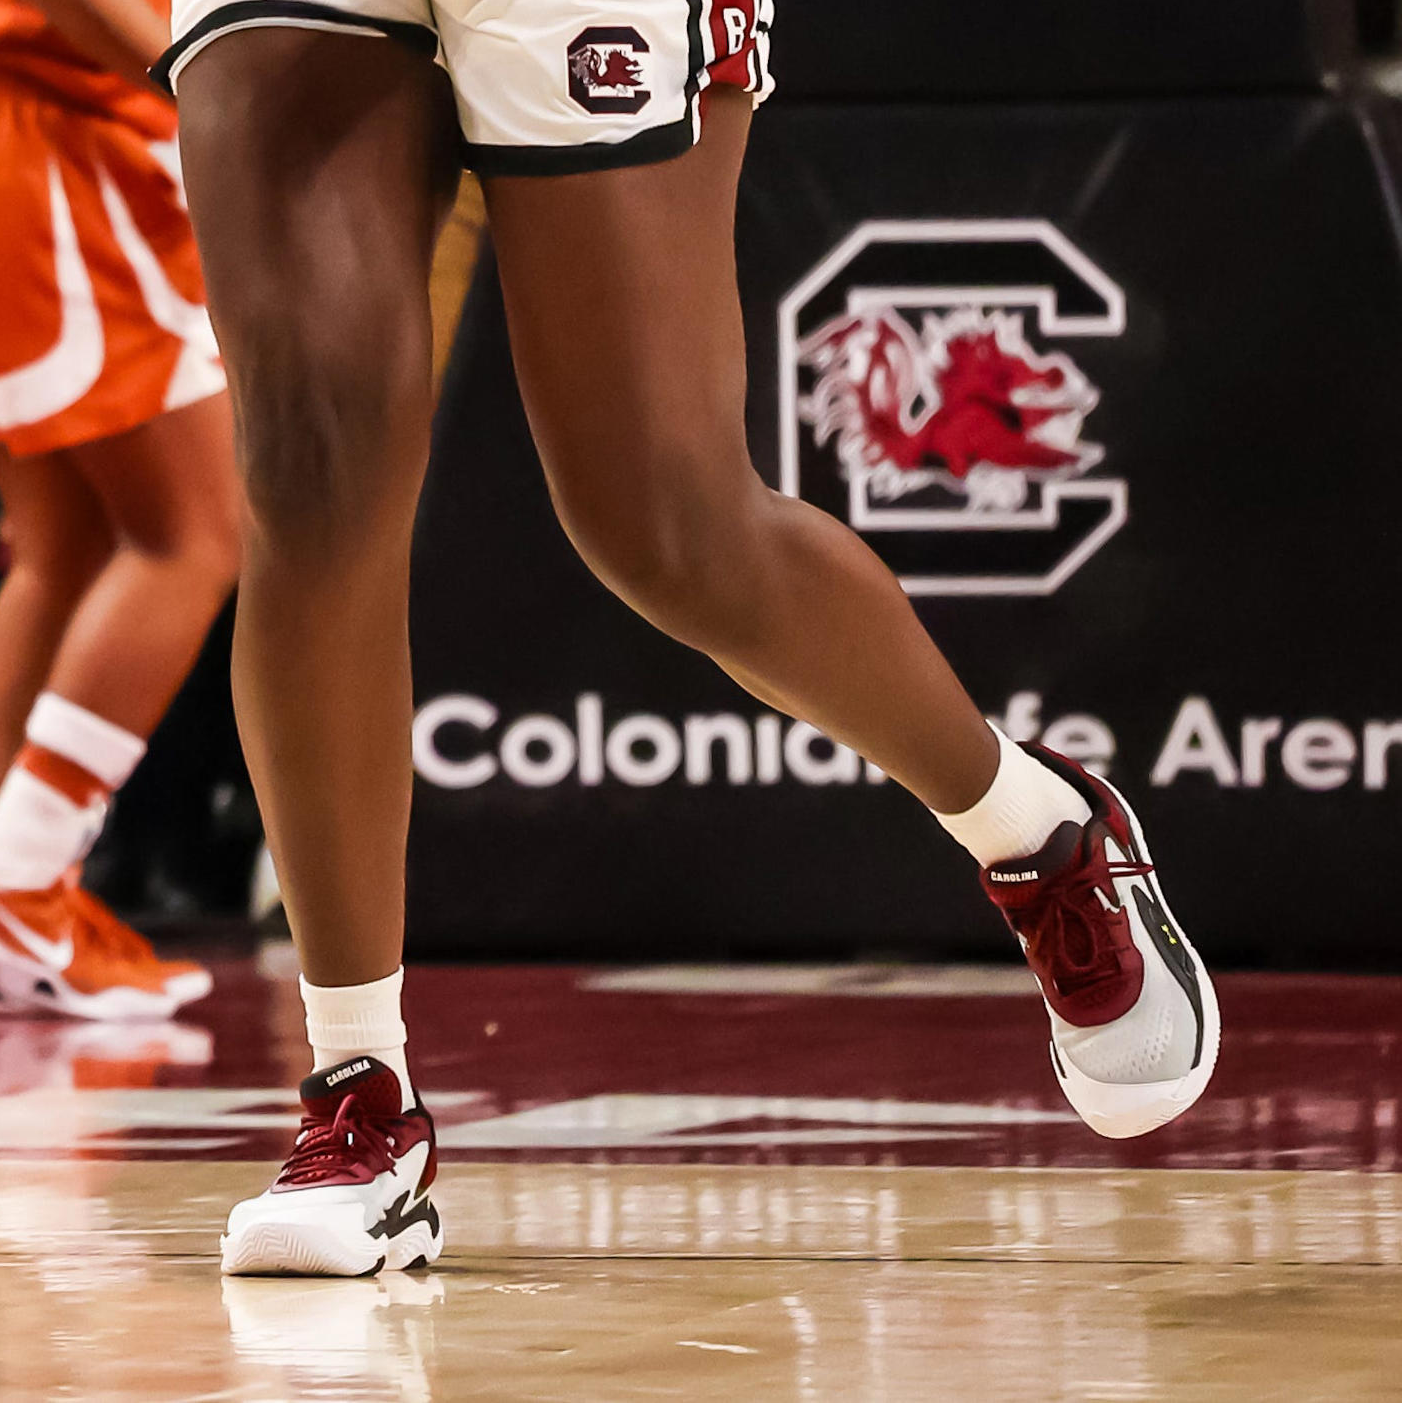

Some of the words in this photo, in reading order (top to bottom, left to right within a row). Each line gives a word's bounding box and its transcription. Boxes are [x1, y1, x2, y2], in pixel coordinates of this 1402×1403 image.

[412, 692, 894, 788] Colonia
[990, 869, 1039, 884] CAROLINA
[325, 1058, 372, 1088] CAROLINA
